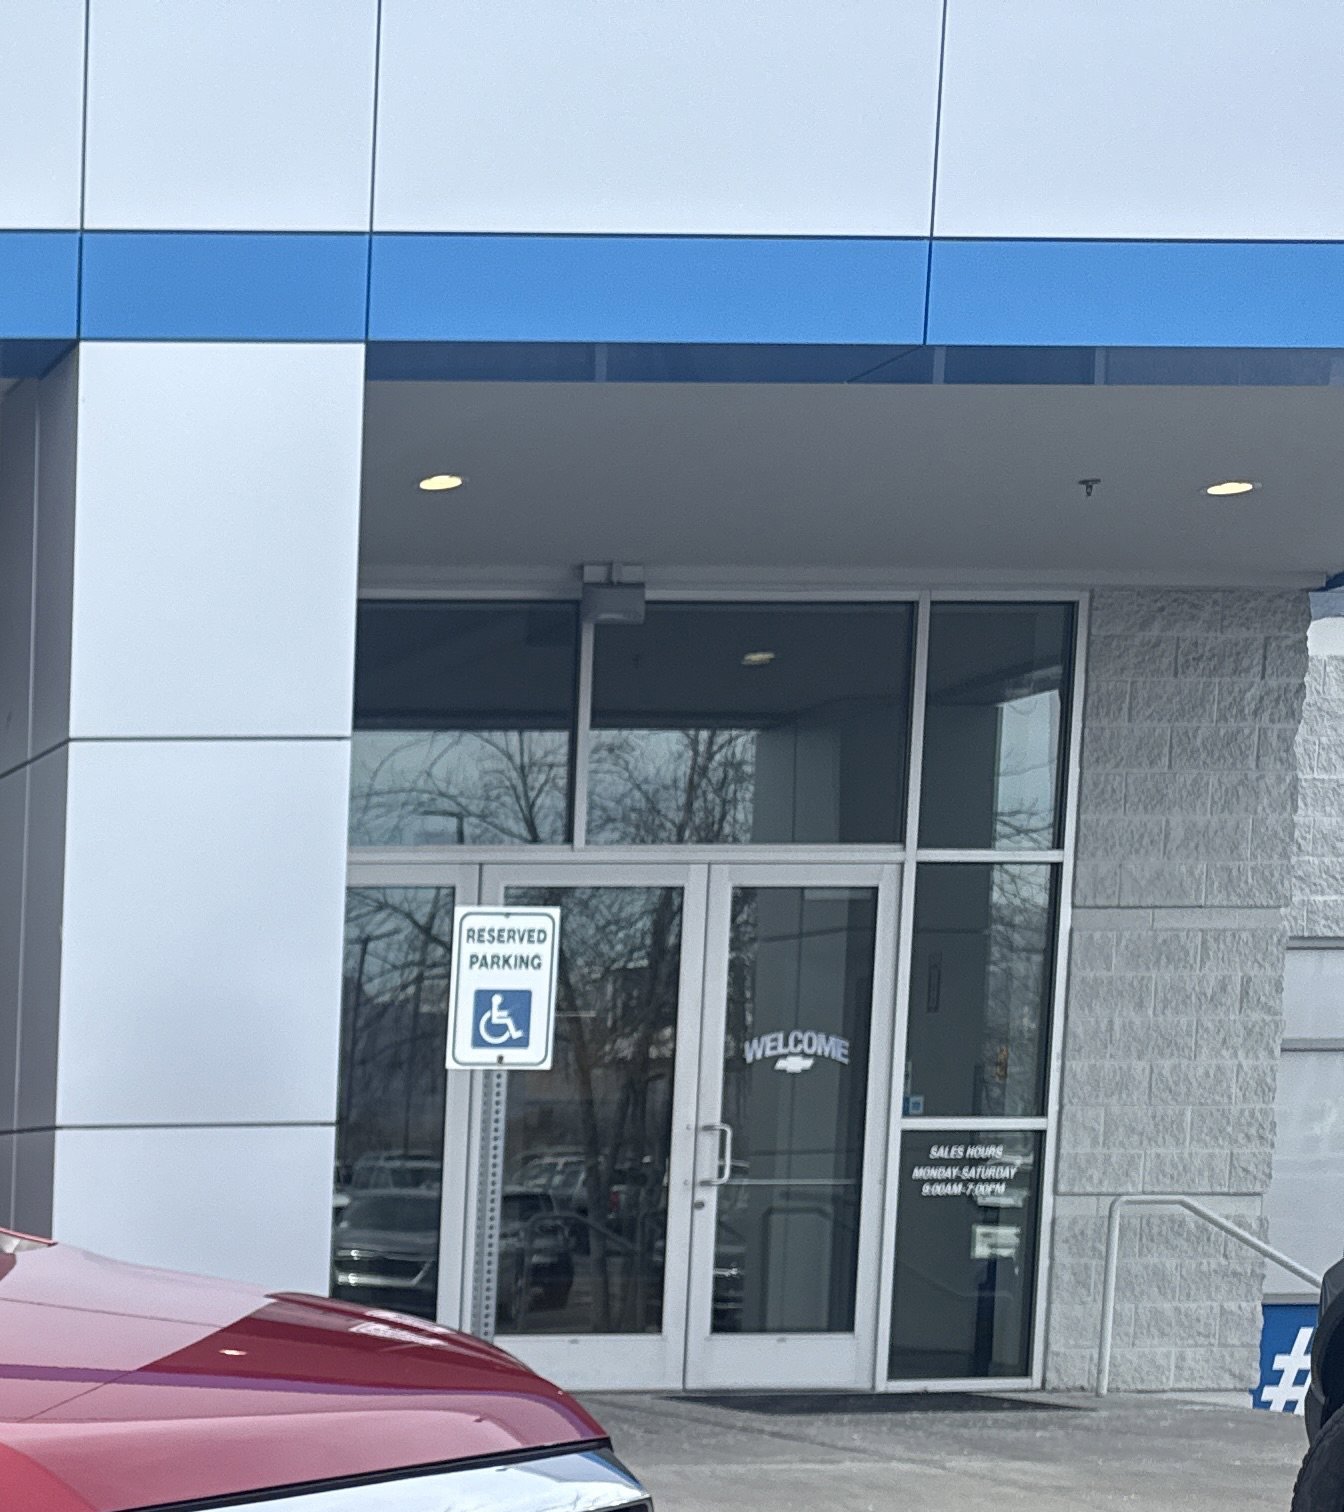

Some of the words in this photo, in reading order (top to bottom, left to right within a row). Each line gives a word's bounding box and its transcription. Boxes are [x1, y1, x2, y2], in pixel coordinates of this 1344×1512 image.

[466, 928, 548, 944] RESERVED
[469, 954, 543, 970] PARKING
[744, 1030, 850, 1065] WELCOME
[929, 1145, 964, 1159] SALES
[965, 1145, 1003, 1159] HOURS
[912, 1165, 1017, 1180] MONDAY-SATURDAY
